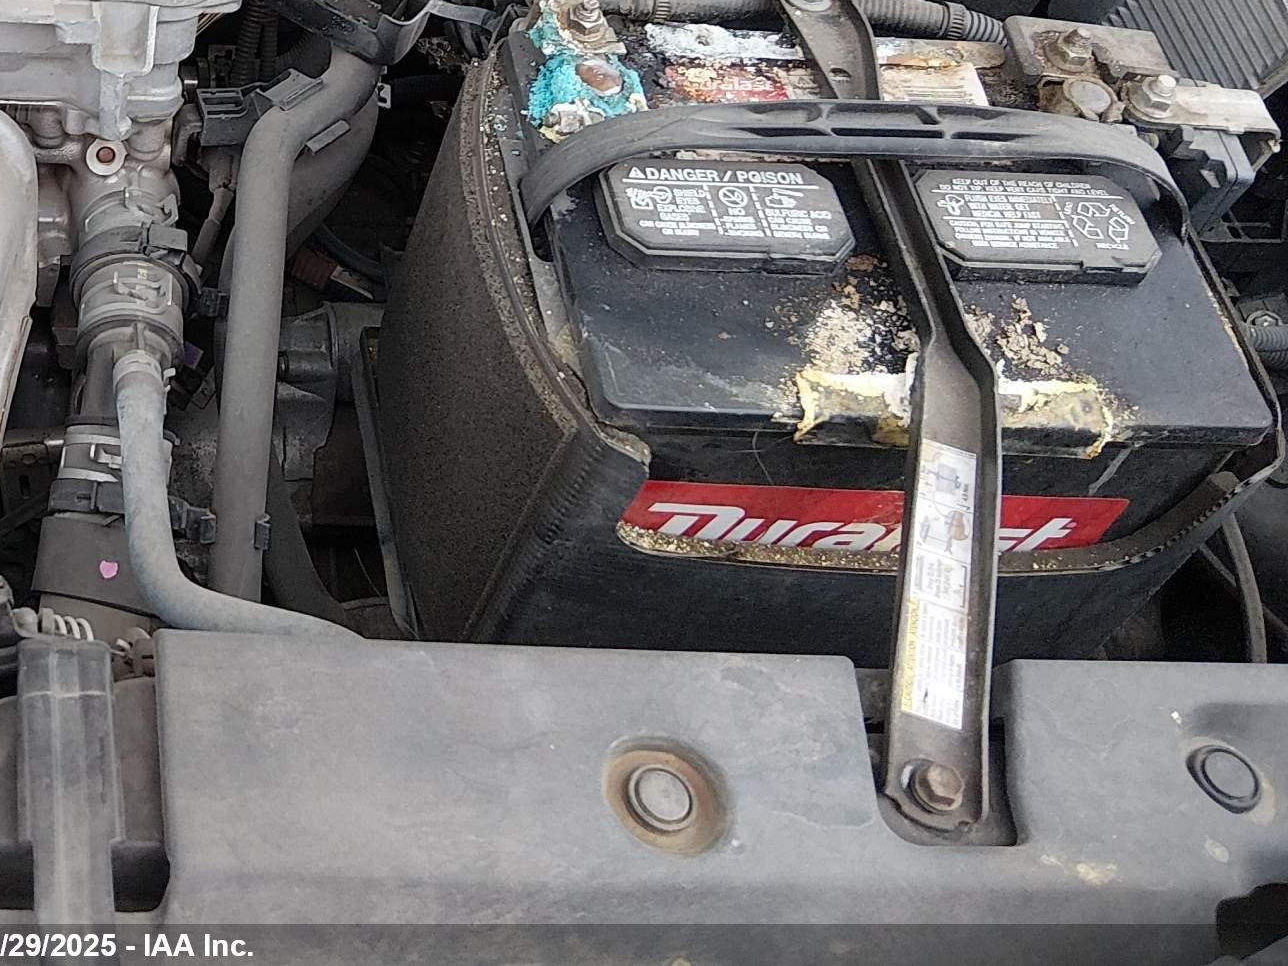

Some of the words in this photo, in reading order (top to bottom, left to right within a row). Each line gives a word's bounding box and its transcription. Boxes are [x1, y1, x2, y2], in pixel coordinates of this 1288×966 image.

[645, 167, 719, 182] DANGER
[736, 170, 803, 185] POISON
[728, 207, 745, 216] NO
